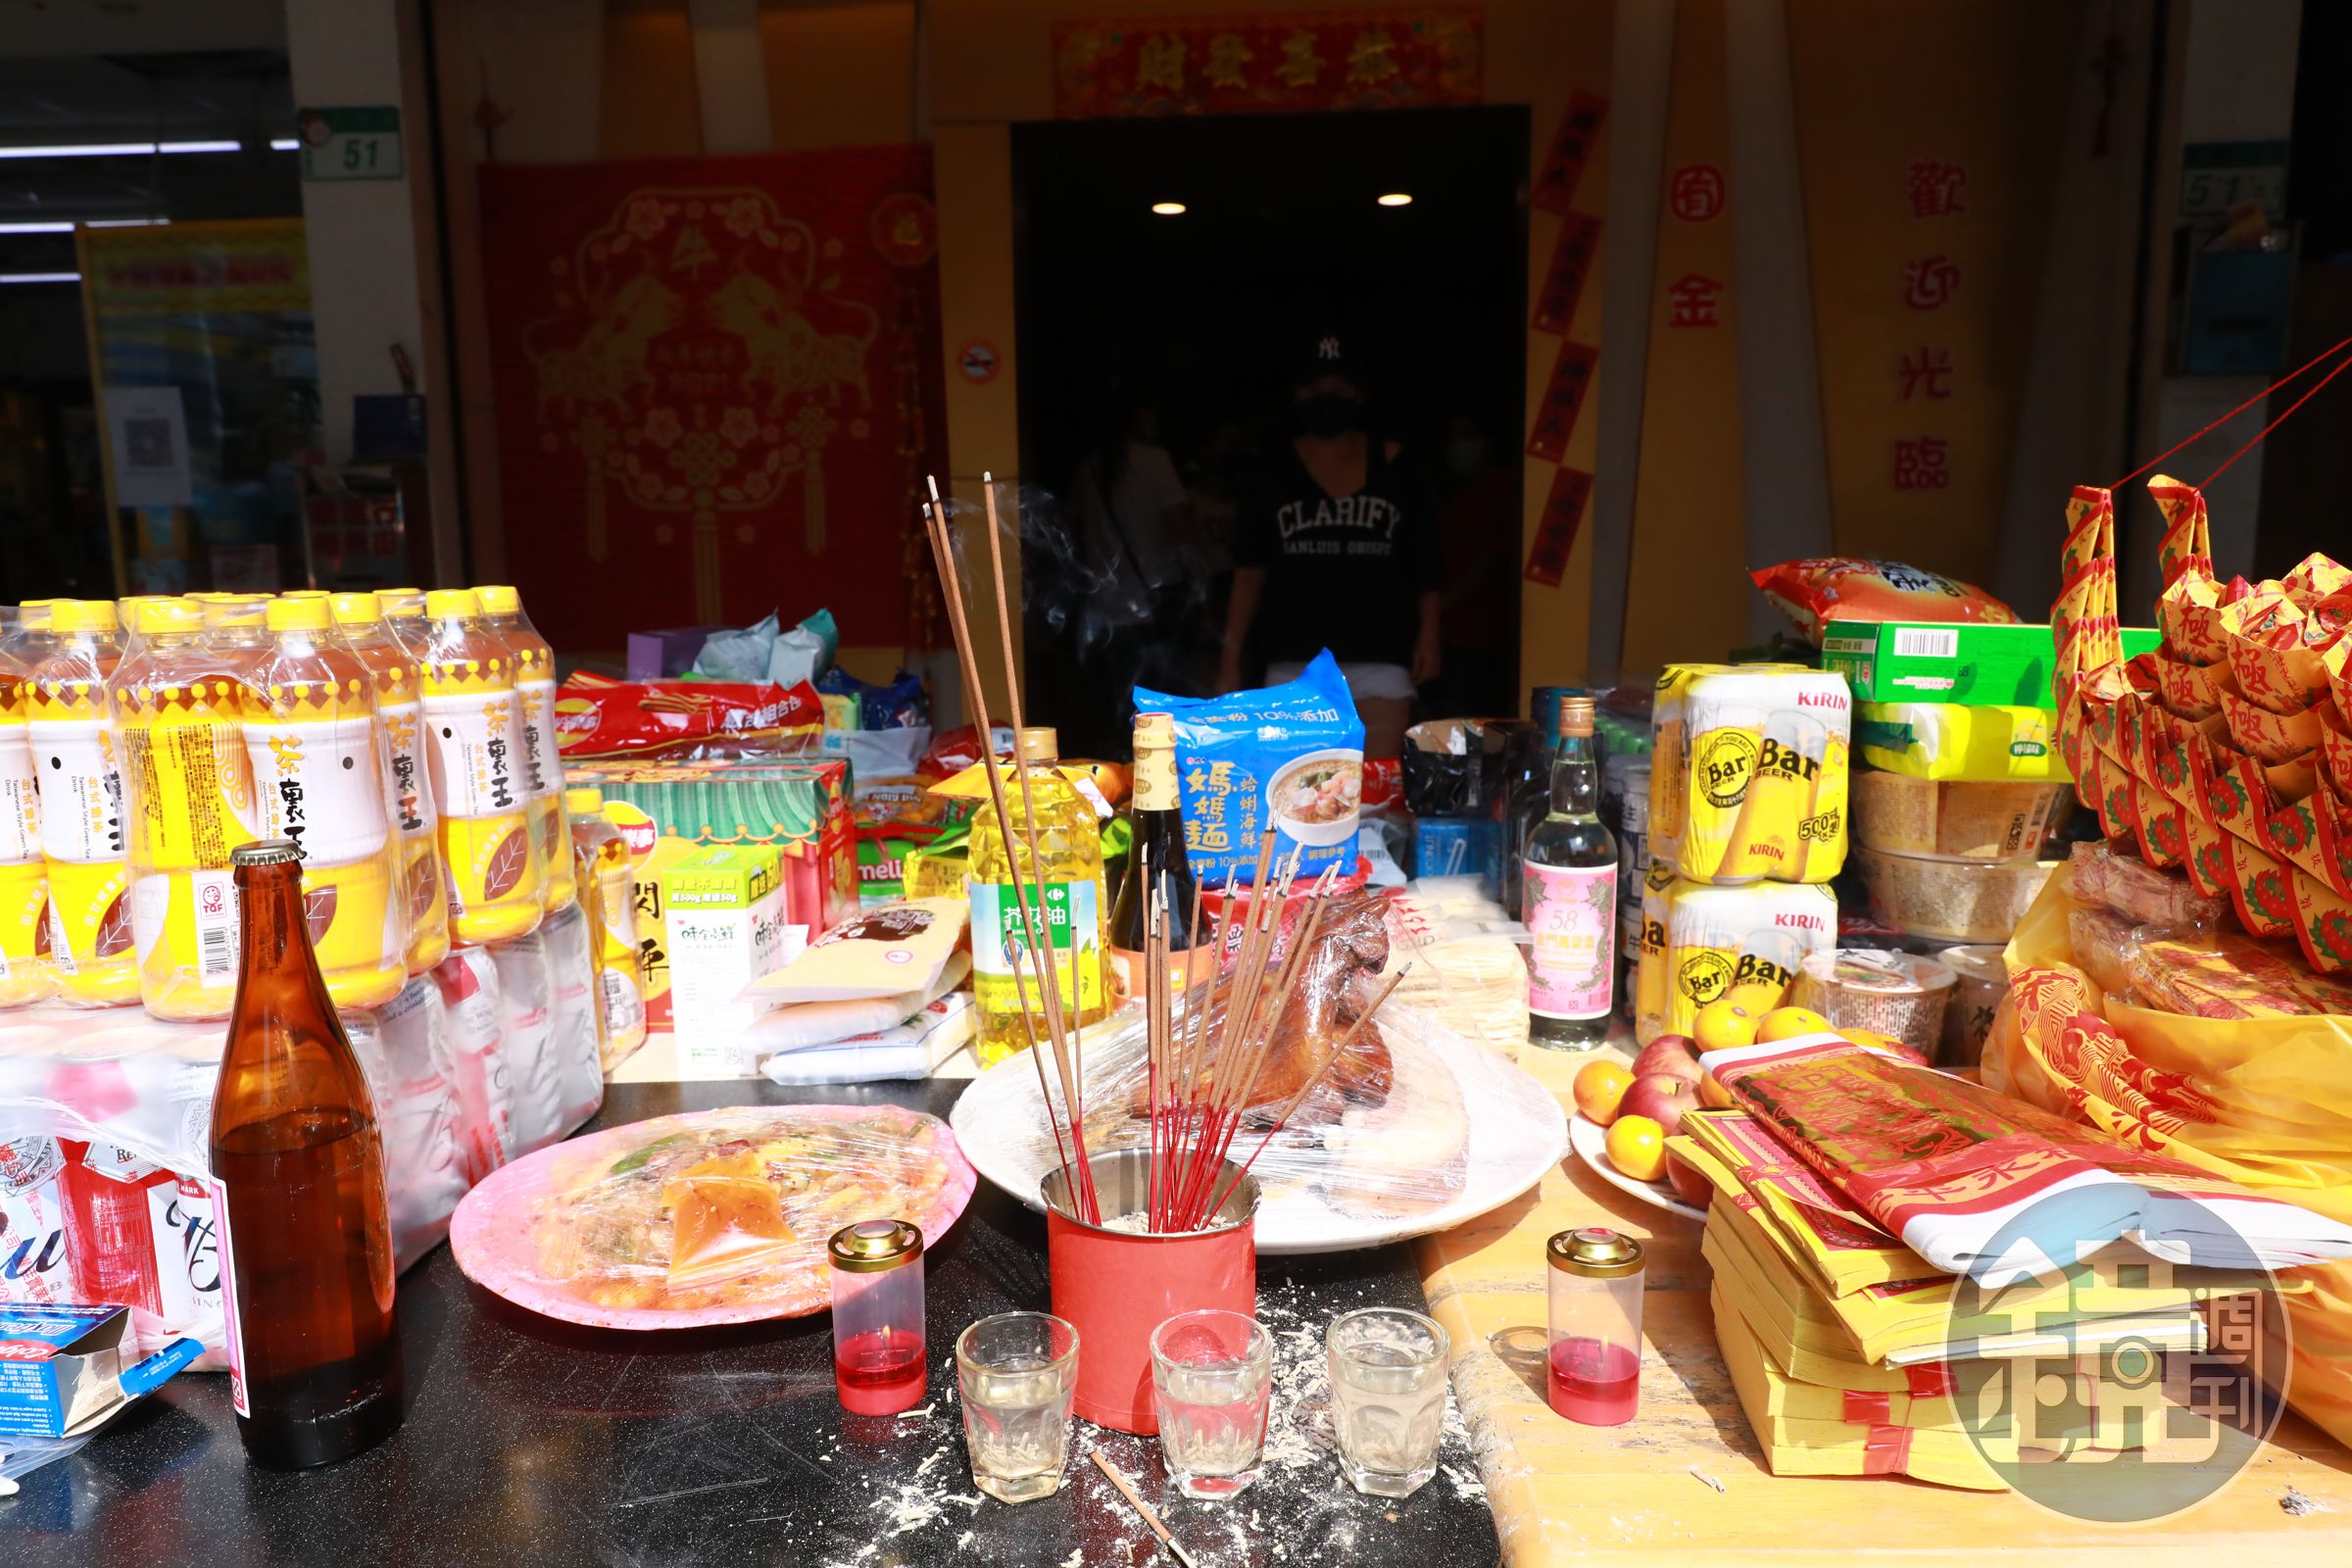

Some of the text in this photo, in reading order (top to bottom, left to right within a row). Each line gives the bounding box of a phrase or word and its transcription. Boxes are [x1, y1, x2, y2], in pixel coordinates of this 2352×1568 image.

[344, 139, 377, 170] 51
[1895, 161, 1968, 492] 歡迎光臨
[1277, 494, 1401, 541] CLARIFY
[1796, 691, 1848, 711] KIRIN
[1706, 756, 1747, 785] Bar
[1756, 737, 1819, 781] Bar
[1184, 761, 1239, 854] 媽媽麵
[1748, 844, 1786, 861] KIRIN
[203, 903, 224, 913] TQF
[1549, 908, 1577, 932] 58
[1775, 912, 1827, 932] KIRIN
[1689, 970, 1721, 991] Bar
[1735, 954, 1792, 988] Bar
